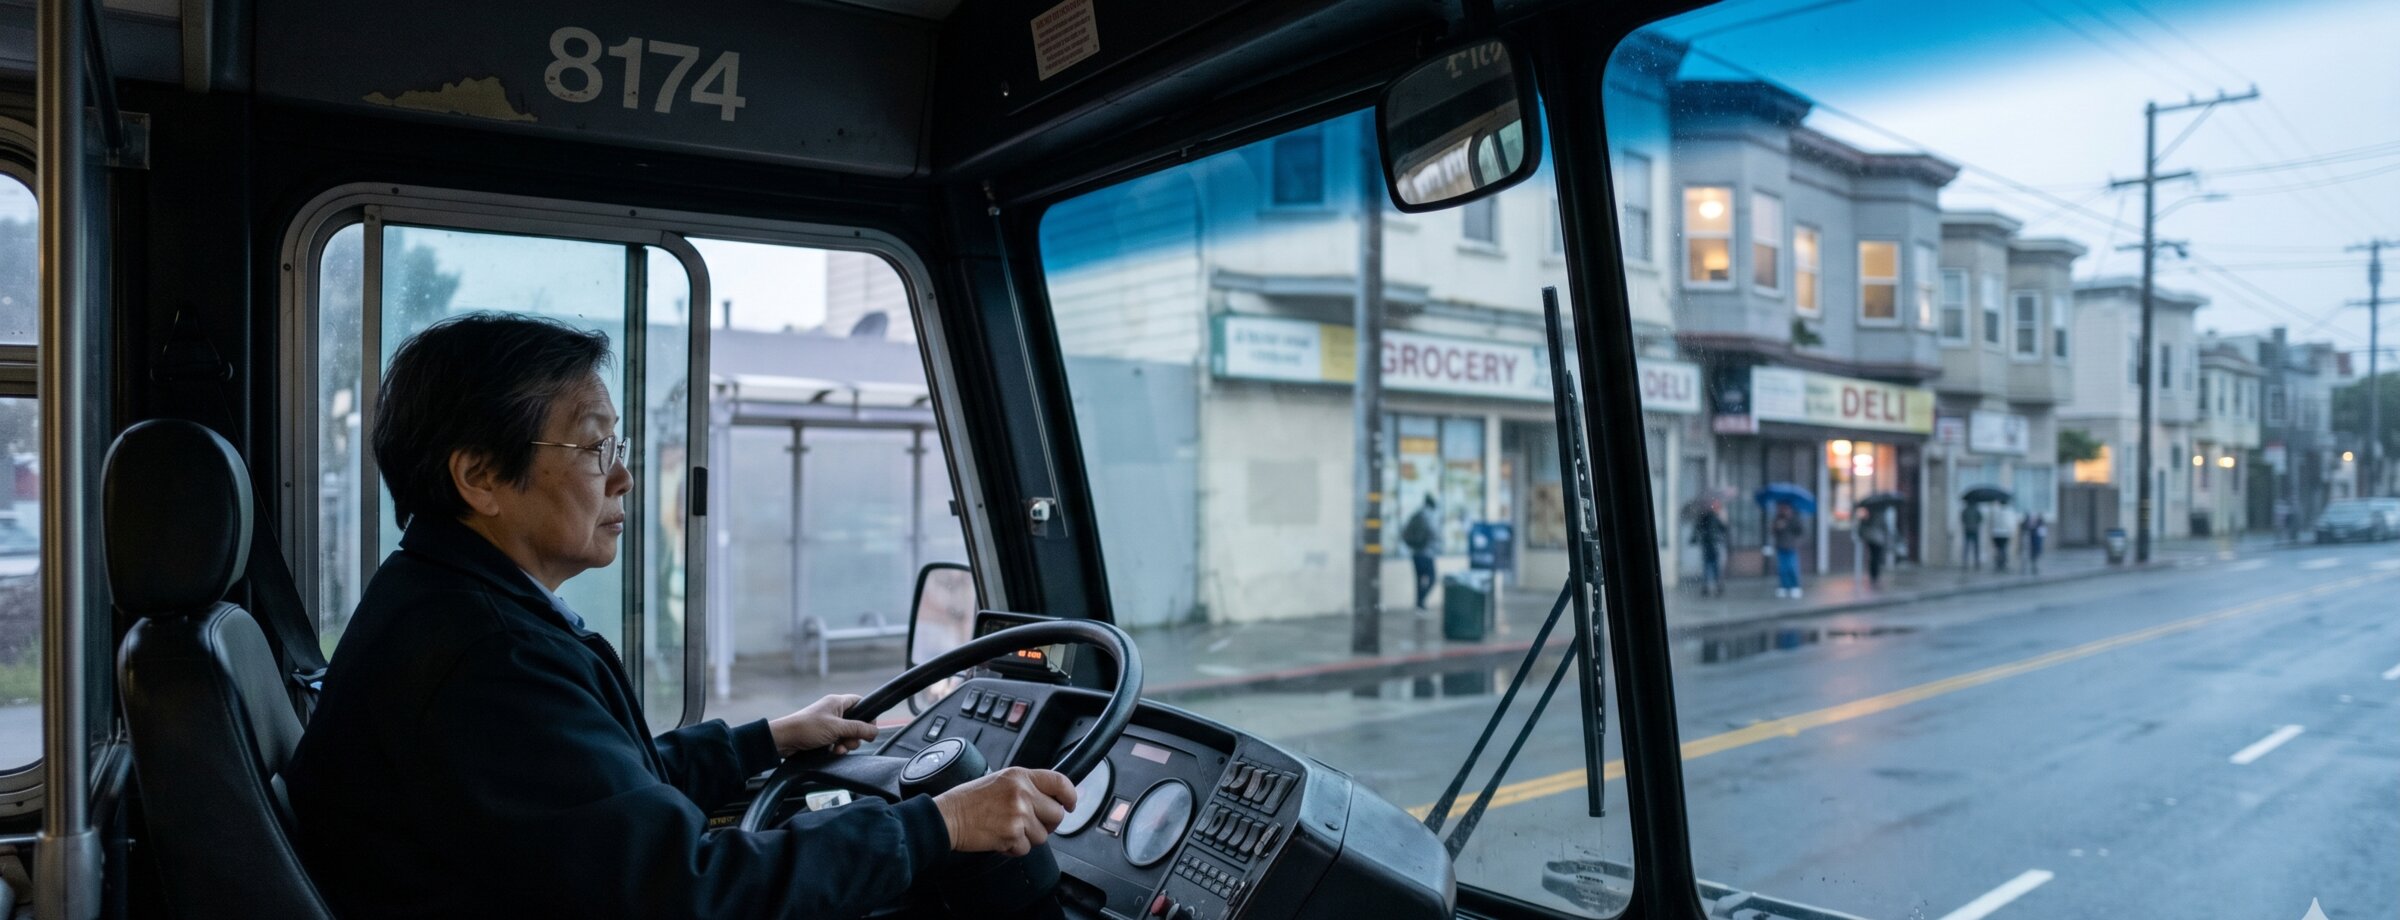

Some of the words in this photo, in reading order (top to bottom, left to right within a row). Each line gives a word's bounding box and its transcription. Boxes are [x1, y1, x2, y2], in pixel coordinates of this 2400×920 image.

[546, 27, 746, 121] 8174
[1382, 341, 1518, 382] GROCERY
[1646, 370, 1692, 400] DELI
[1843, 387, 1906, 422] DELI
